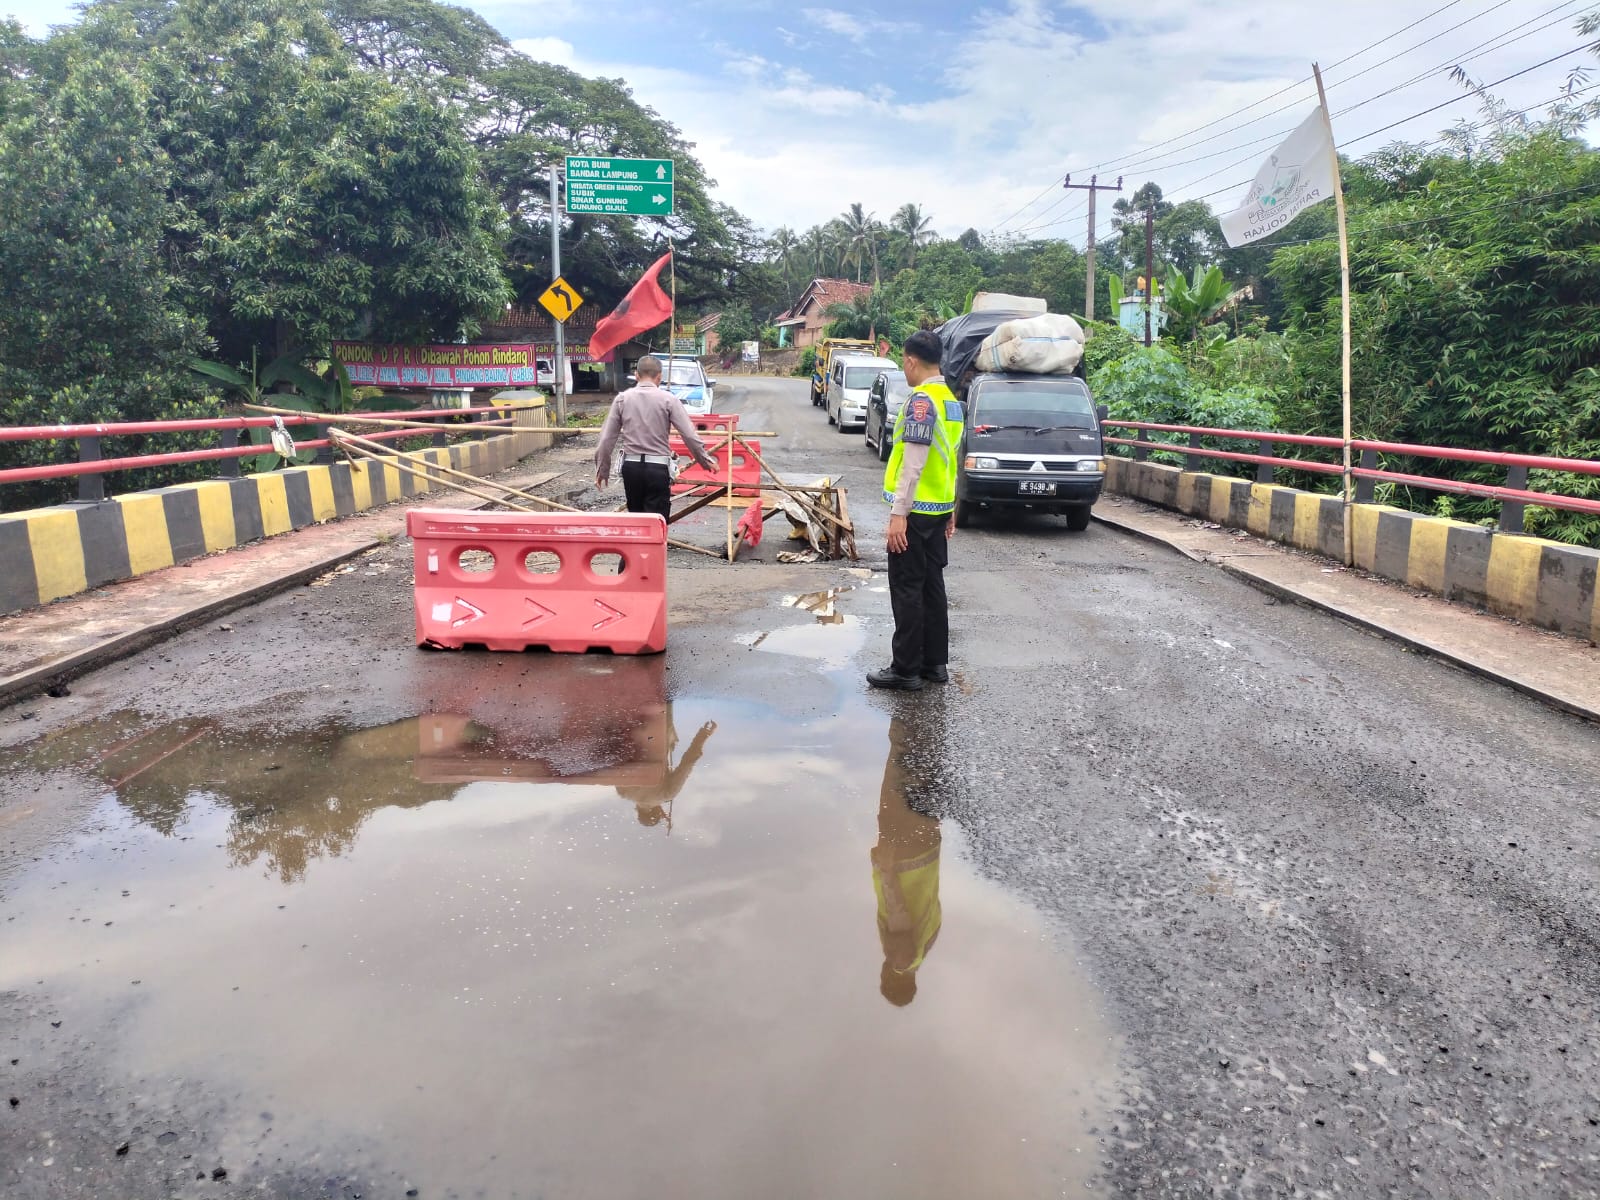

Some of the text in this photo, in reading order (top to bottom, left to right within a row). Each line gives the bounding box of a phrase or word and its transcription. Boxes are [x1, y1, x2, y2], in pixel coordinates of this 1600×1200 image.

[570, 160, 589, 168] KOTA
[570, 170, 638, 179] BANDAR LAMPUNG
[336, 344, 373, 362] PONDOK
[392, 347, 399, 364] P
[404, 347, 410, 364] R
[464, 348, 490, 364] Pohon
[455, 368, 483, 383] PINDANG
[511, 367, 534, 382] GABUS
